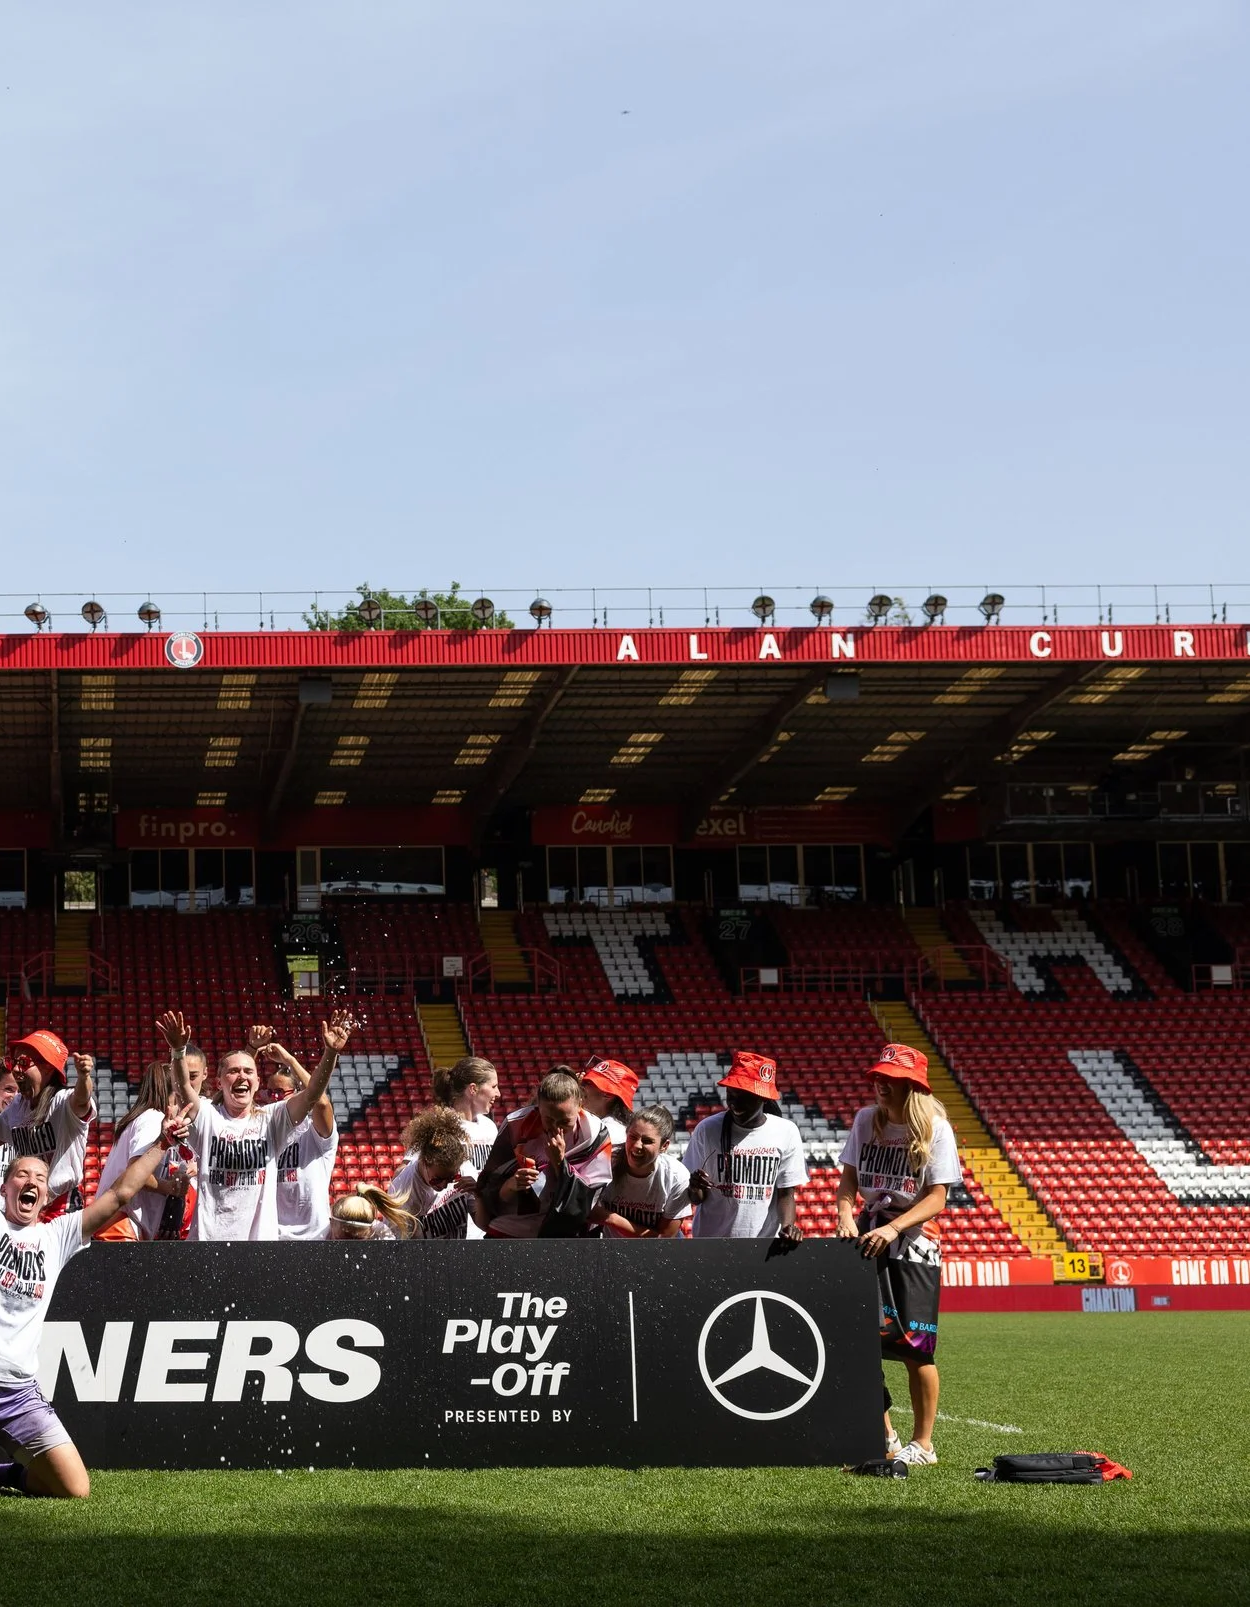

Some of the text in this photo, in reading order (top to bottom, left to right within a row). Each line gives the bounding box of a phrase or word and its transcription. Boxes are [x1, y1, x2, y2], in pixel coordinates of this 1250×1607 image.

[1029, 630, 1250, 658] CUR
[138, 815, 237, 843] finpro.
[571, 810, 634, 835] Candid
[290, 923, 323, 943] 26
[718, 920, 752, 940] 27
[976, 1260, 1009, 1287] ROAD
[1069, 1258, 1086, 1273] 13
[1171, 1259, 1250, 1286] COME ON YO
[497, 1292, 568, 1318] The
[1081, 1287, 1137, 1313] CHARLTON
[442, 1319, 559, 1362] Play
[470, 1362, 571, 1396] -Off
[445, 1409, 573, 1423] PRESENTED BY
